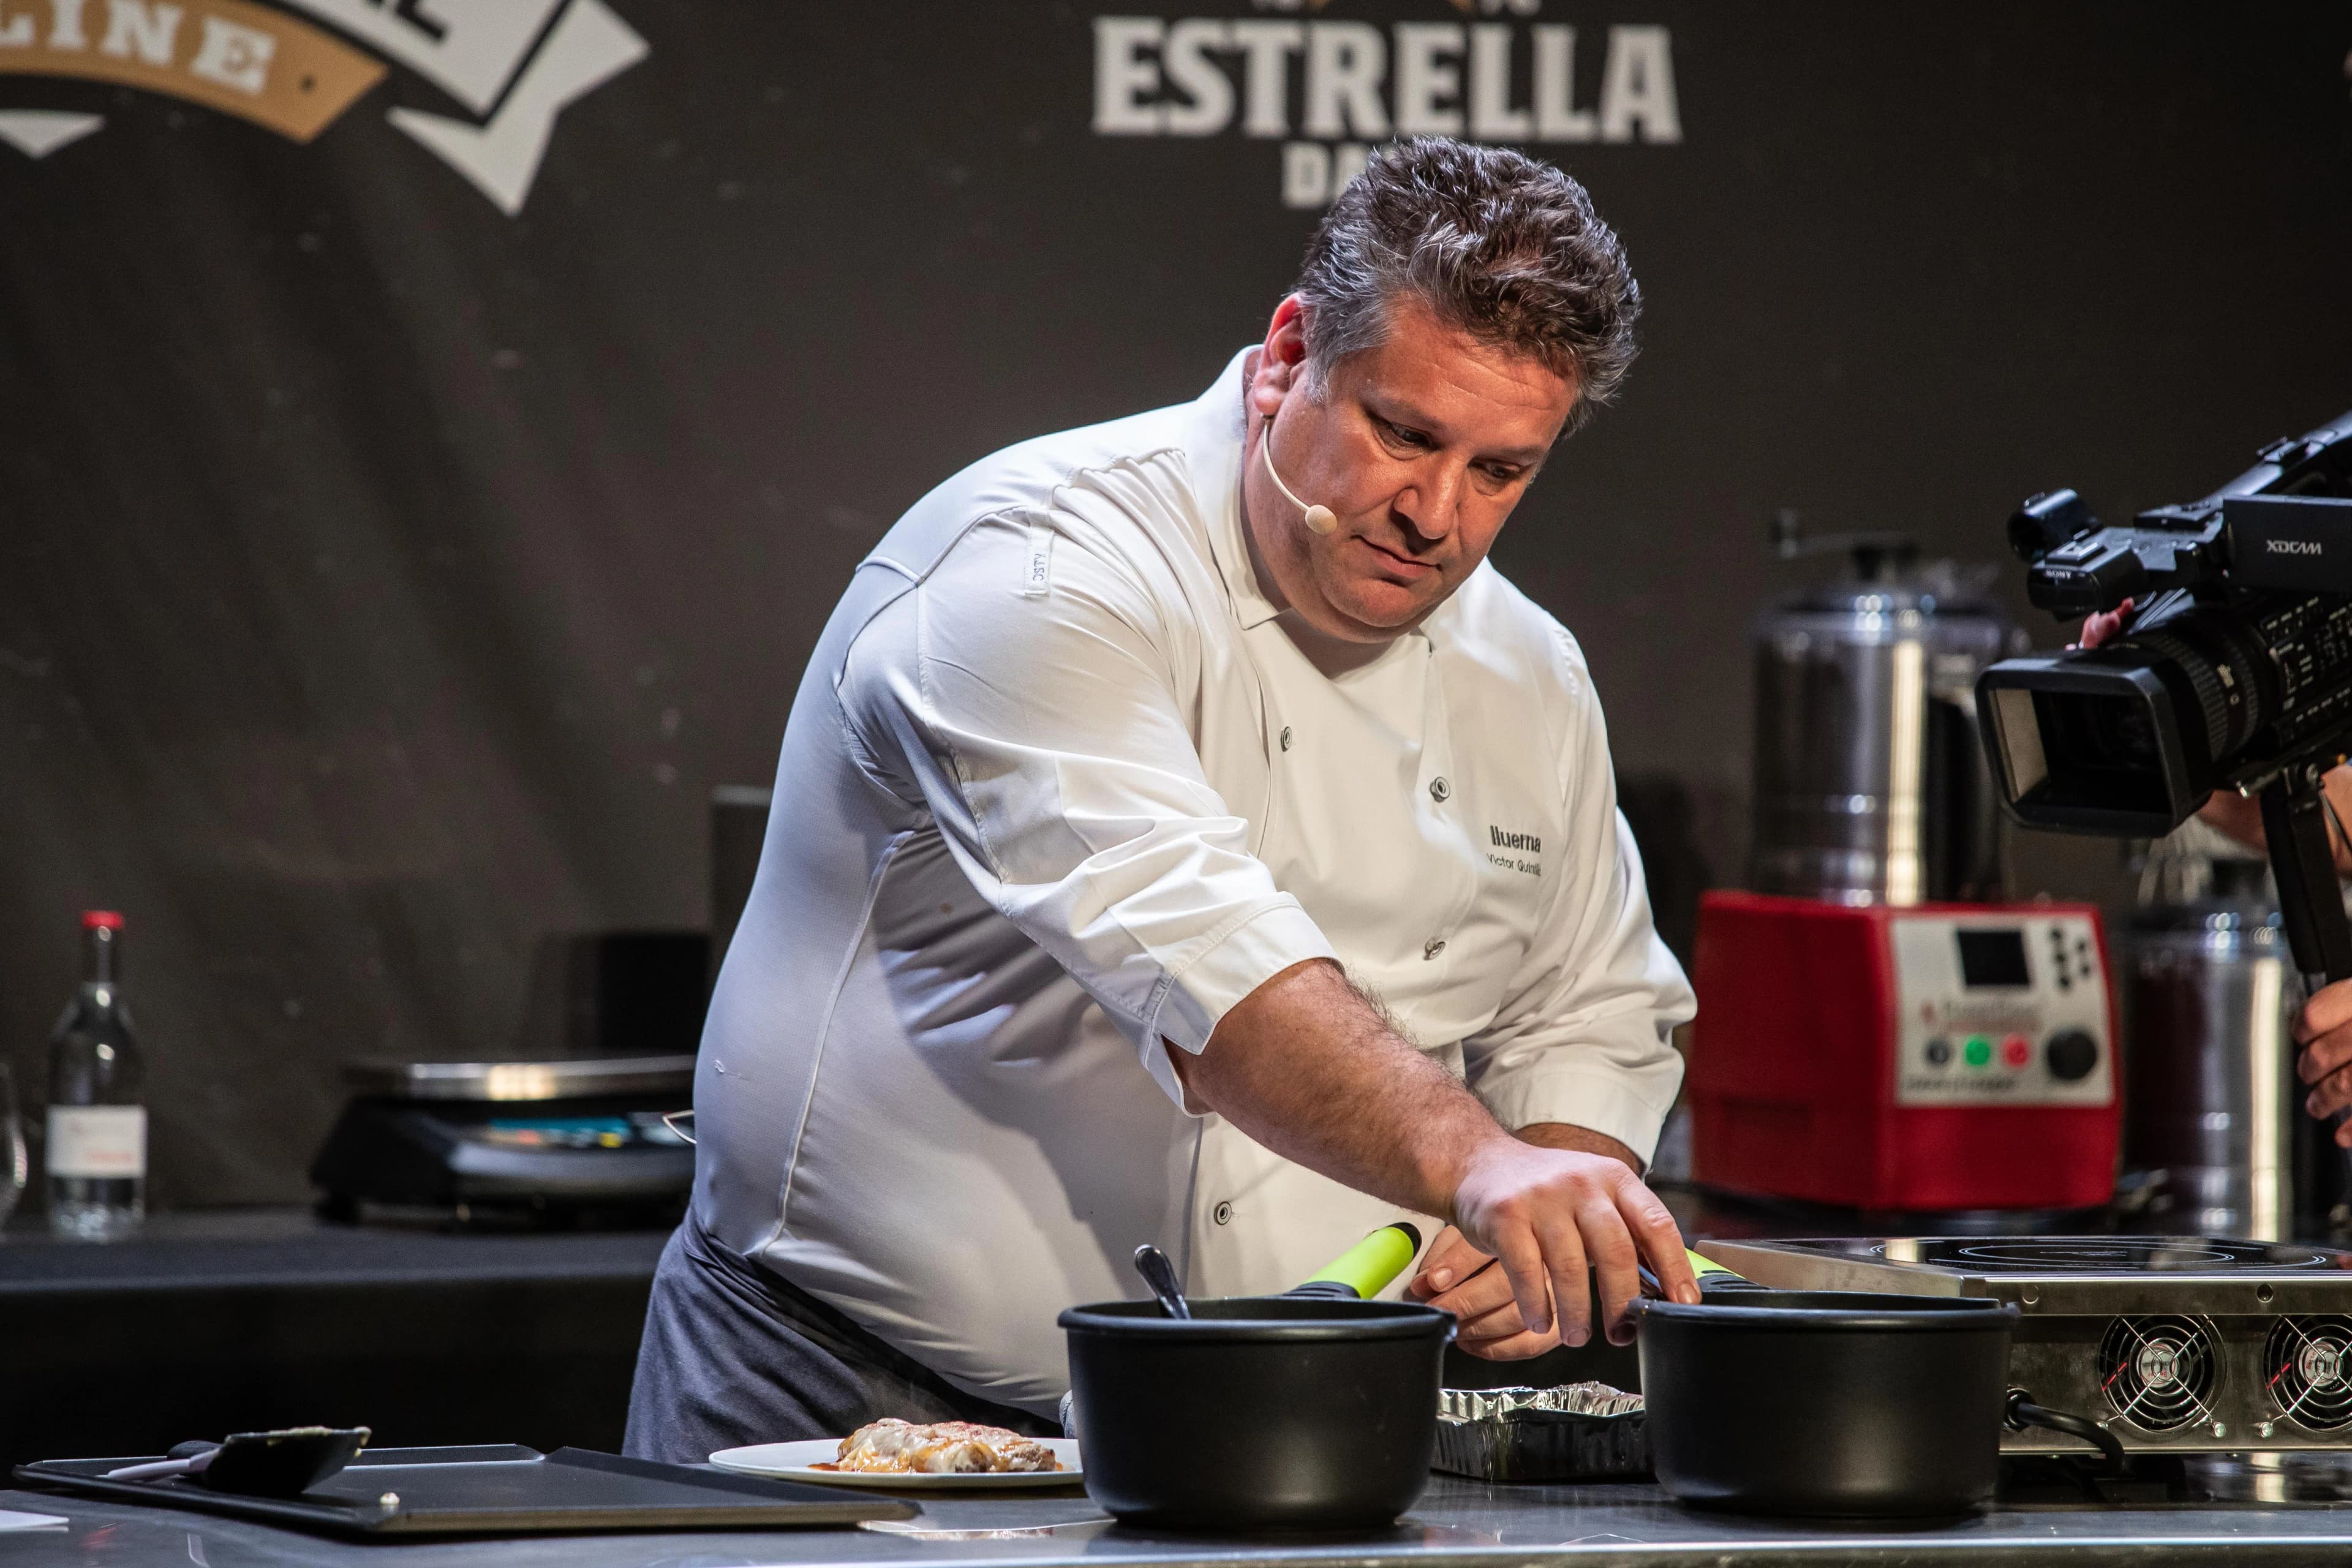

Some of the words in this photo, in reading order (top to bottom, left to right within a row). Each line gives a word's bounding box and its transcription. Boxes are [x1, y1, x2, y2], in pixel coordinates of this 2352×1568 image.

[1092, 17, 1682, 143] ESTRELLA
[2267, 540, 2322, 555] XDCAM
[2045, 569, 2071, 579] SONY
